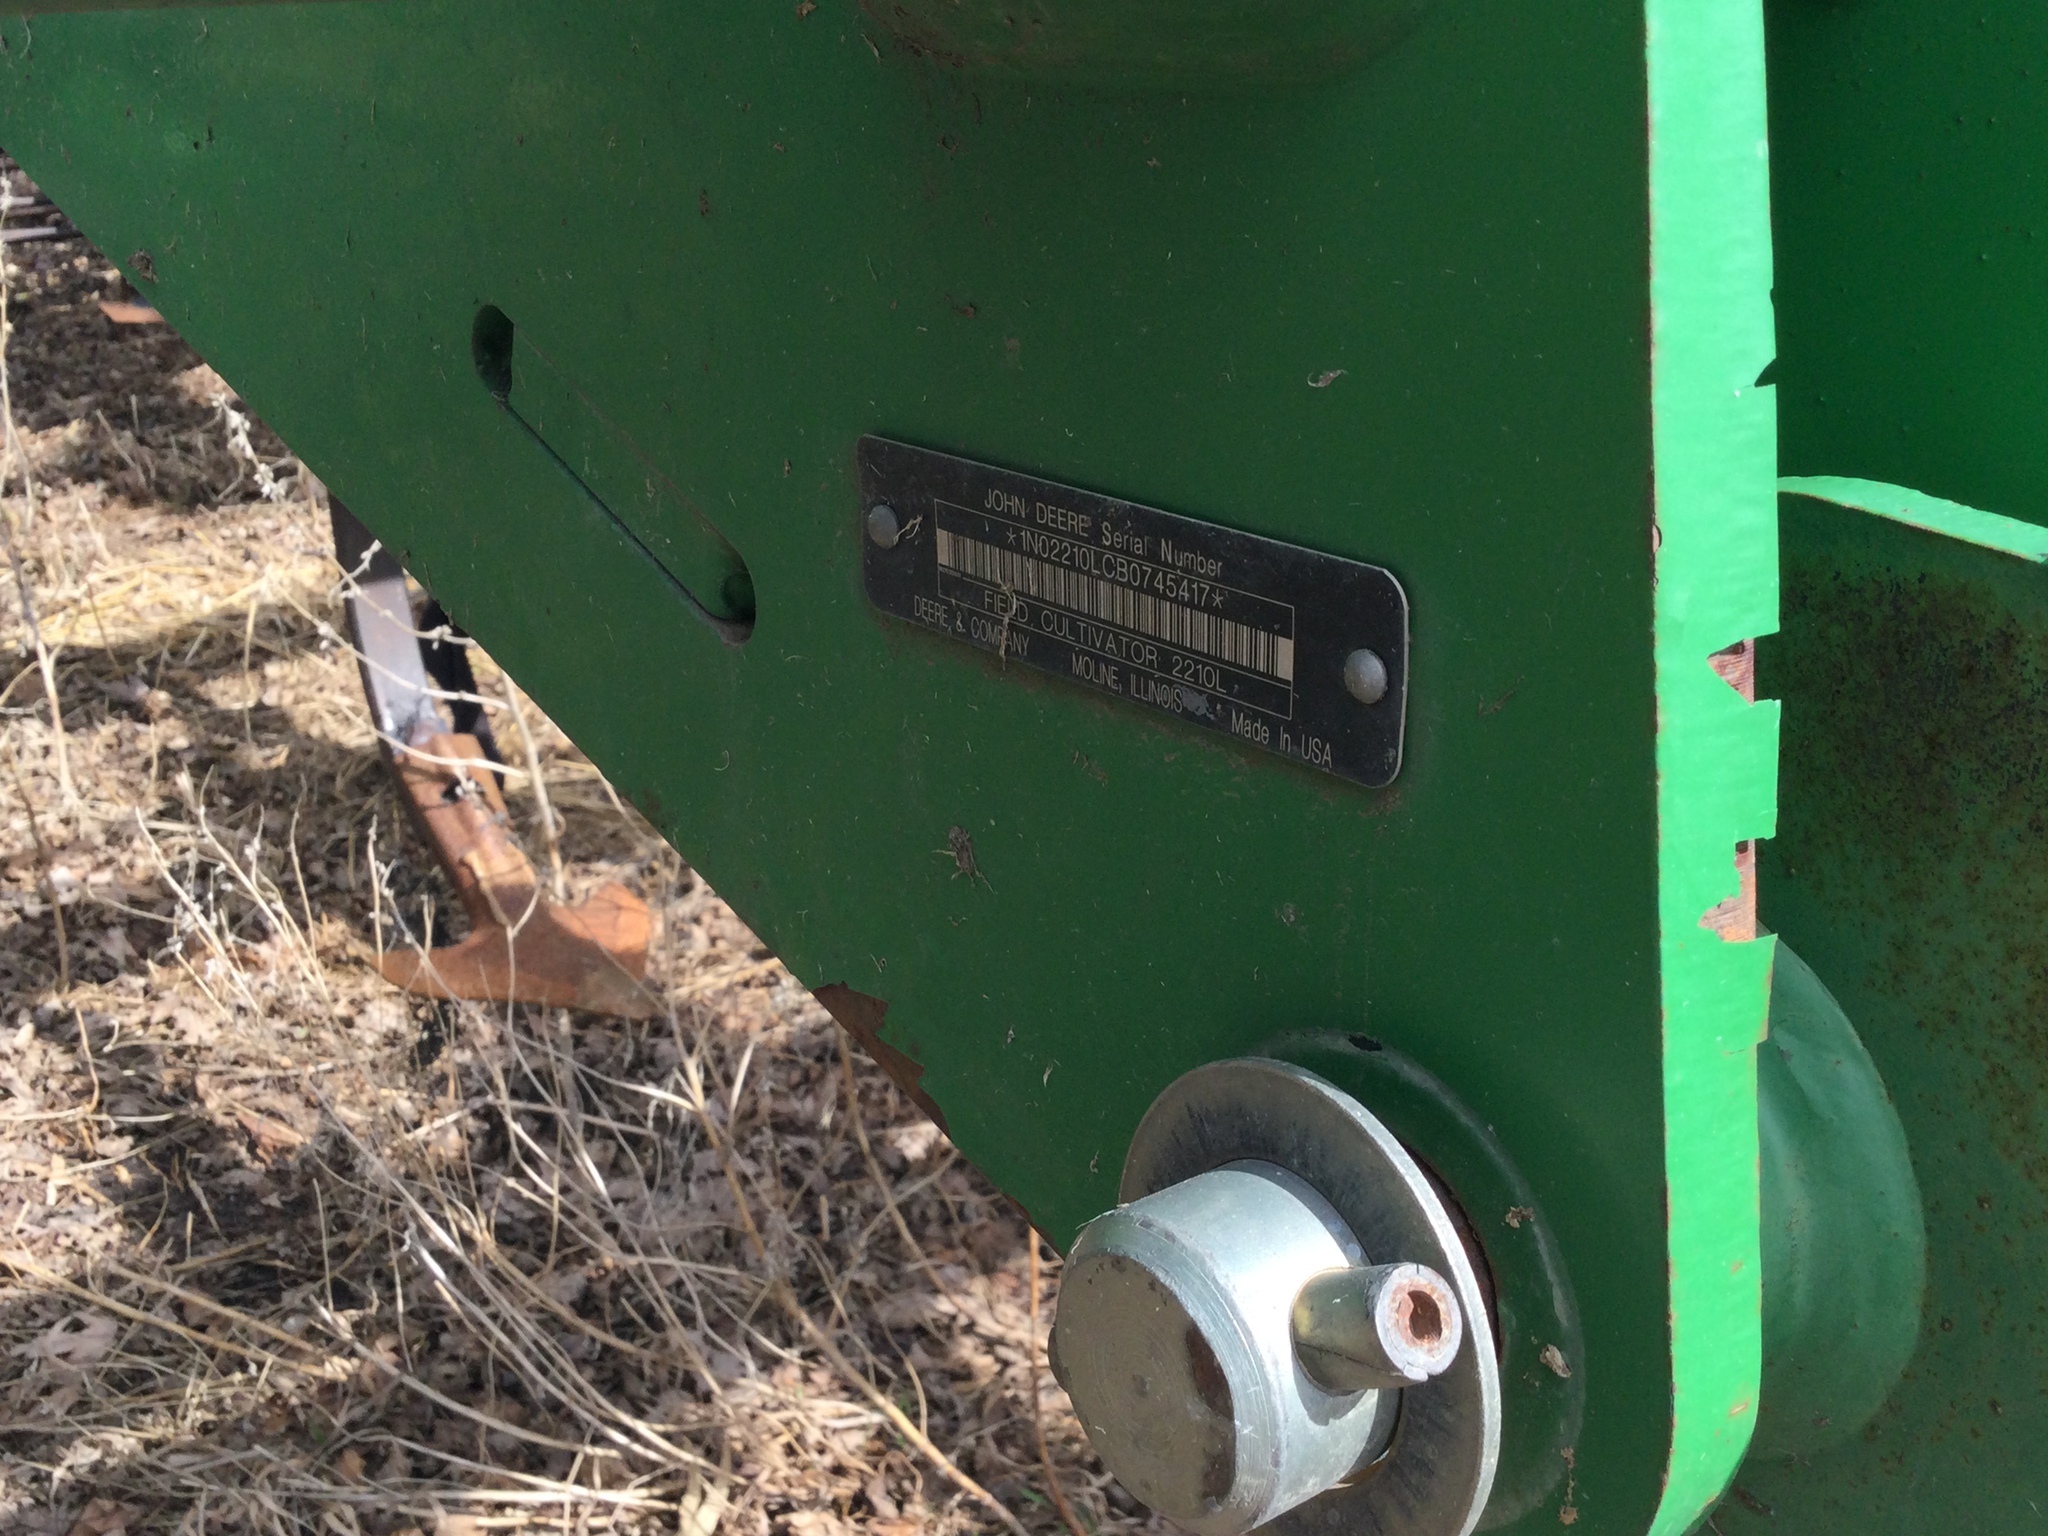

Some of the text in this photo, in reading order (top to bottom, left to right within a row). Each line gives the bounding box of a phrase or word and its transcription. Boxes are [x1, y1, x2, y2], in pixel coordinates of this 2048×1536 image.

[984, 489, 1223, 578] JOHN DEERE Serial Number
[914, 595, 1183, 714] DEERE & COMPANY MOLINE, ILLINOIS
[984, 590, 1227, 694] FIELD CULTIVATOR 2210L
[1231, 708, 1270, 745] Made
[1301, 734, 1333, 769] USA
